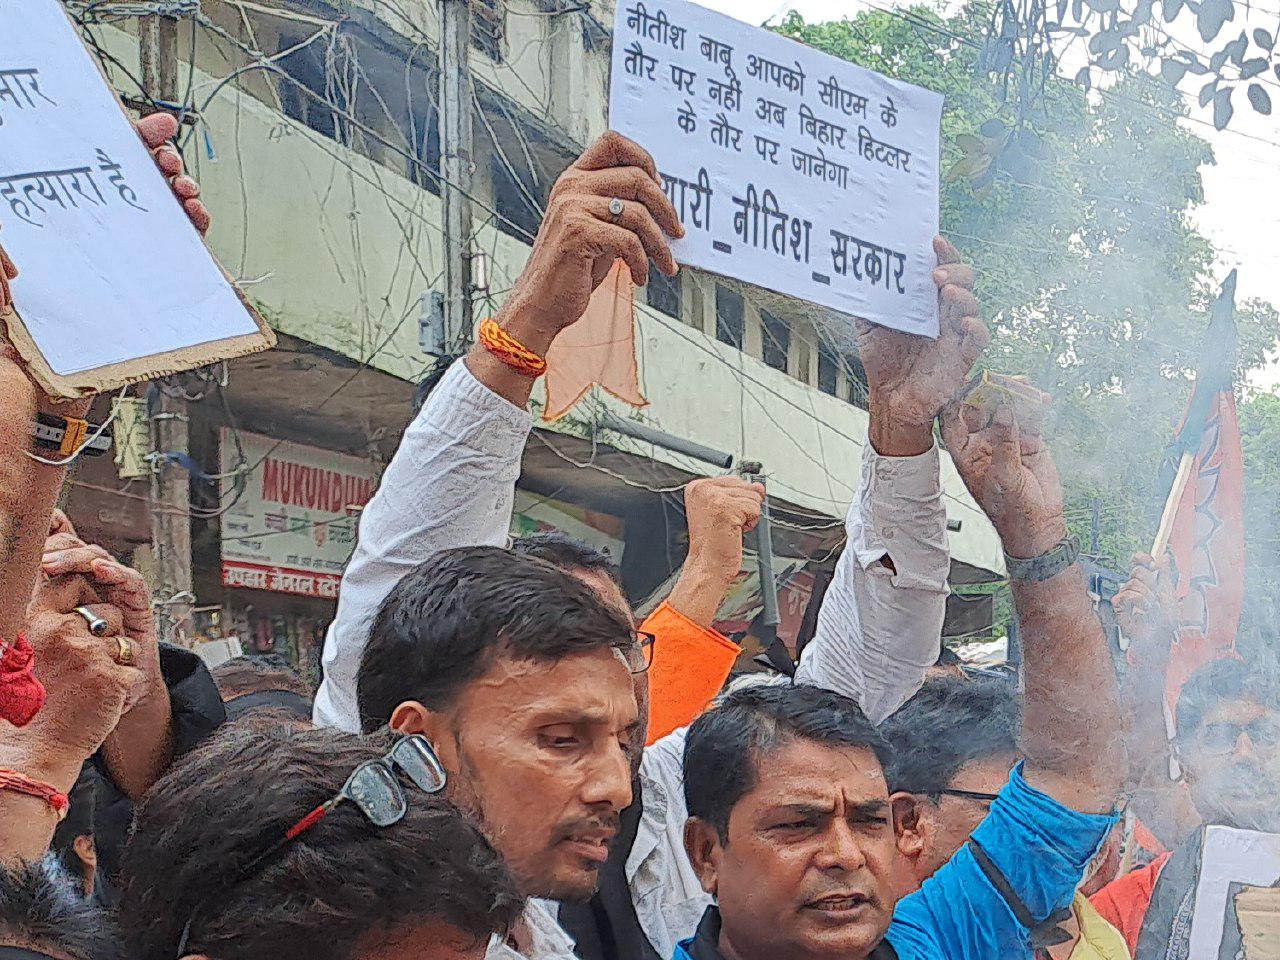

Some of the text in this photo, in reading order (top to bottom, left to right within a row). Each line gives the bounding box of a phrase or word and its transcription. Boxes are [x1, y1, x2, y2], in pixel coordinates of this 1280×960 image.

[624, 41, 659, 80] तौर
[669, 64, 696, 96] पर
[755, 97, 787, 128] अब
[799, 103, 847, 151] बिहार
[858, 125, 912, 173] हिटलर
[699, 34, 736, 79] बाबू
[746, 54, 806, 96] आपको
[818, 75, 868, 120] सीएम
[880, 96, 899, 128] के
[95, 148, 149, 212] है
[678, 101, 850, 190] के तौर पर जानेगा
